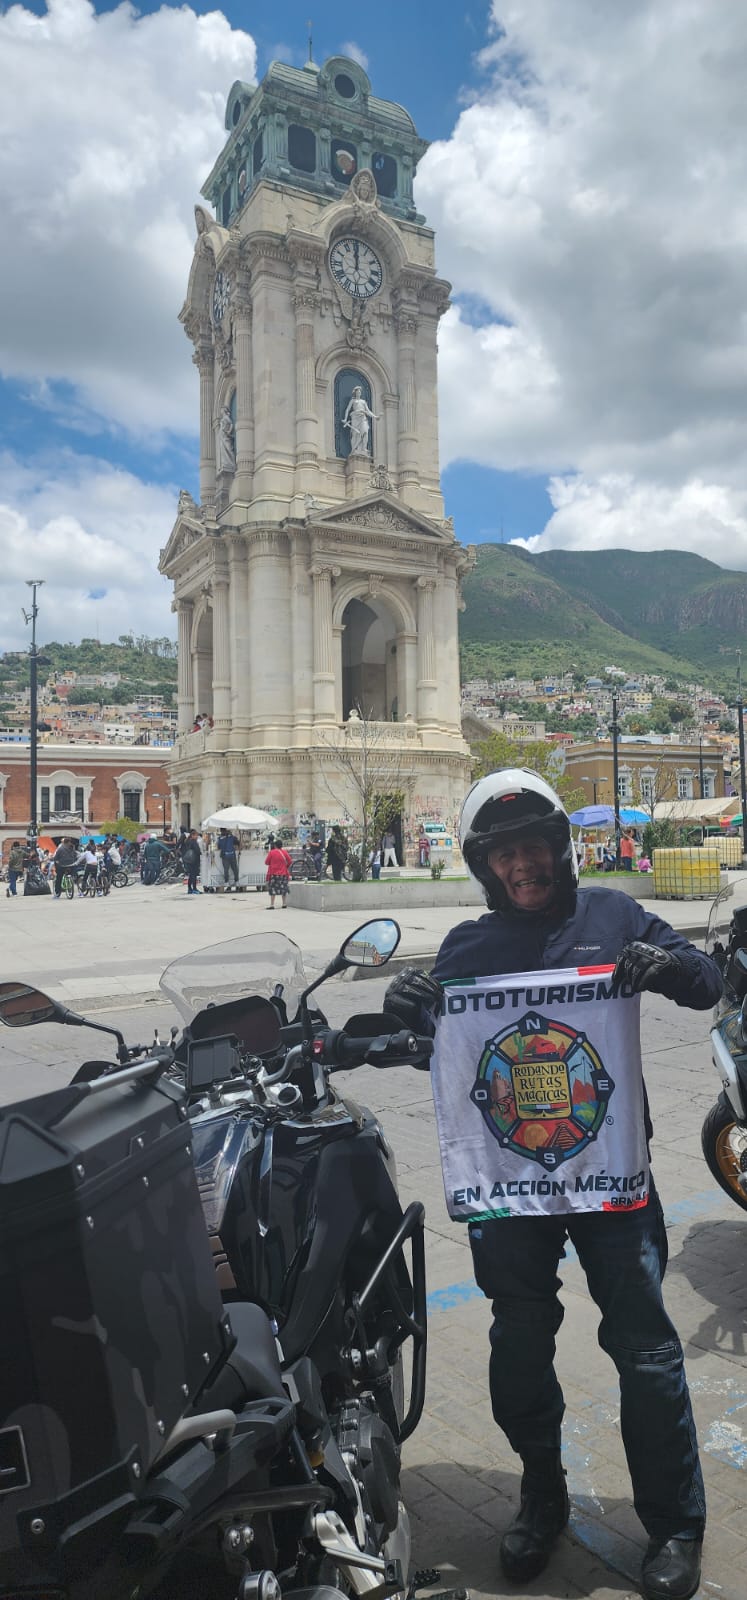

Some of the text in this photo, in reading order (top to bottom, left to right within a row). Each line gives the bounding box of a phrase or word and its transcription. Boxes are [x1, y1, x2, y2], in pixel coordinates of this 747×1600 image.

[526, 1018, 541, 1031] N
[597, 1079, 609, 1091] E
[475, 1089, 488, 1101] O
[543, 1152, 556, 1164] S
[453, 1169, 646, 1206] EN ACCIÓN MÉXICO
